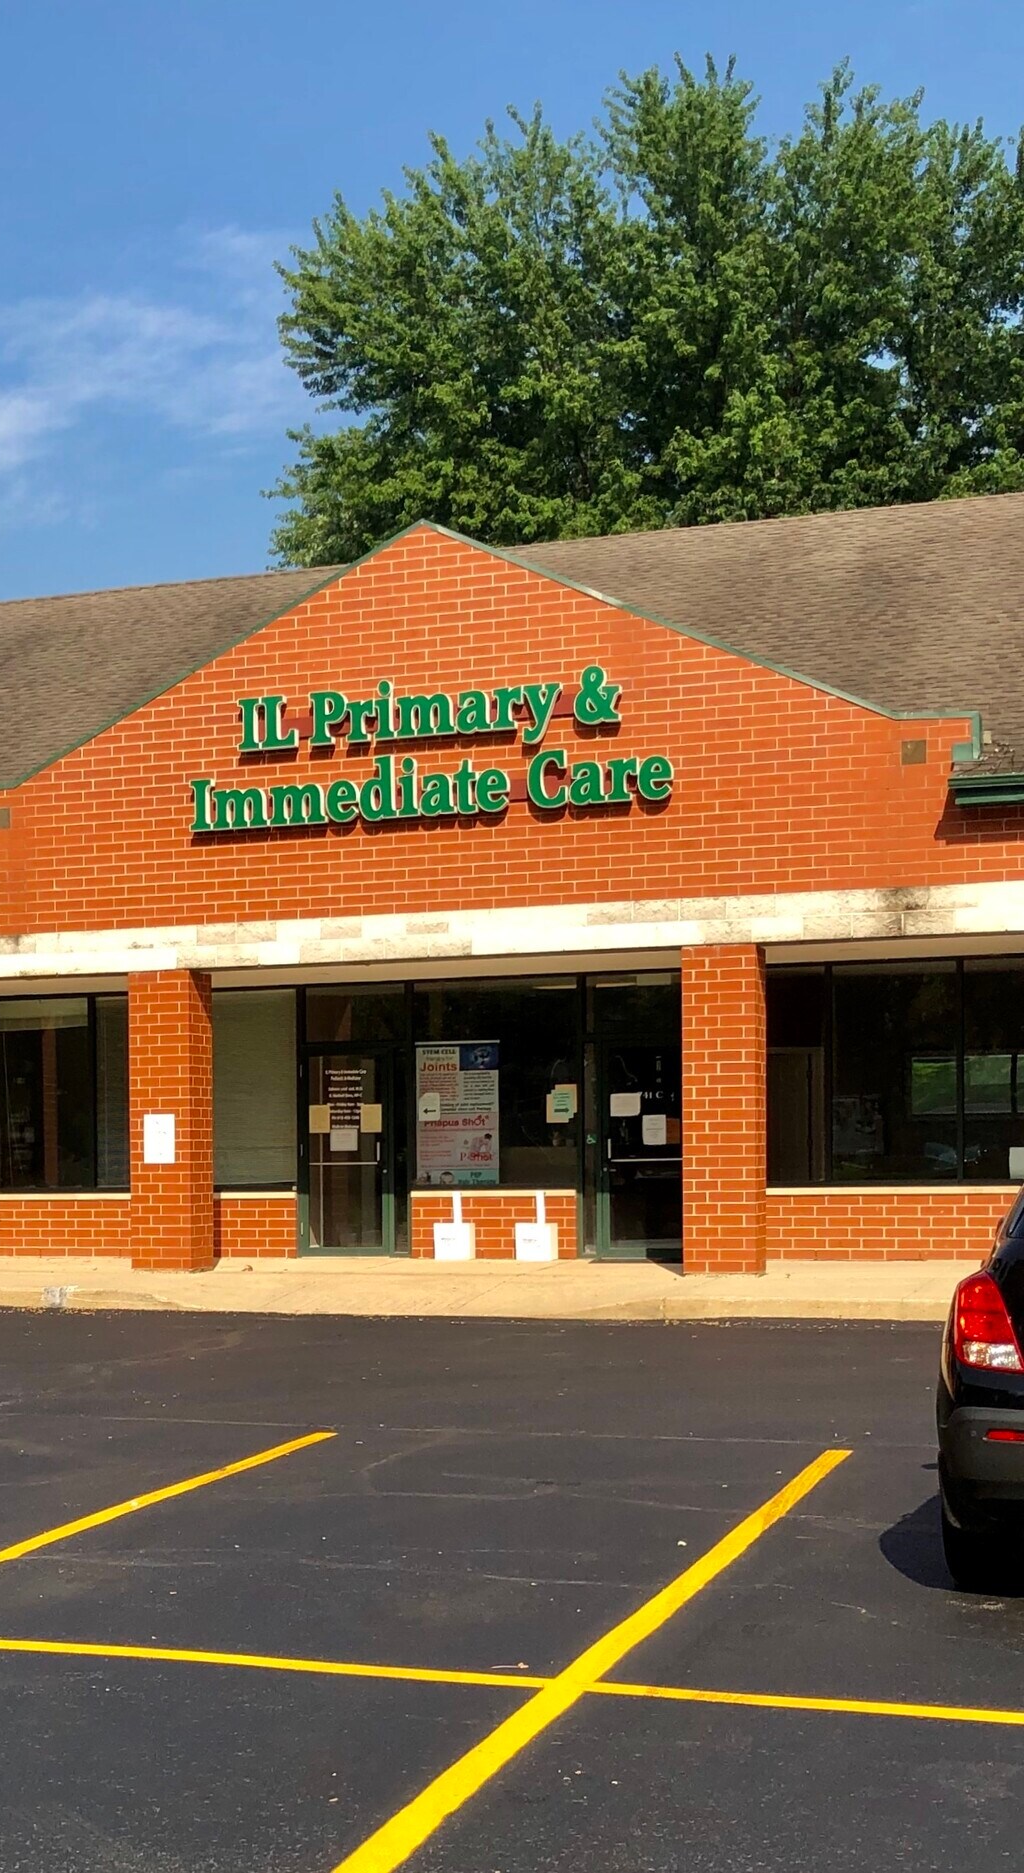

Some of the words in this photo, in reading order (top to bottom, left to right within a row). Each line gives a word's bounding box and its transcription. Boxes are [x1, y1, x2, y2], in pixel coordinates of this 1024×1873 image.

[237, 695, 299, 752] IL
[308, 680, 563, 745] Primary
[573, 665, 622, 726] &
[190, 754, 509, 833] Immediate
[527, 749, 674, 810] Care
[420, 1062, 458, 1072] Joints
